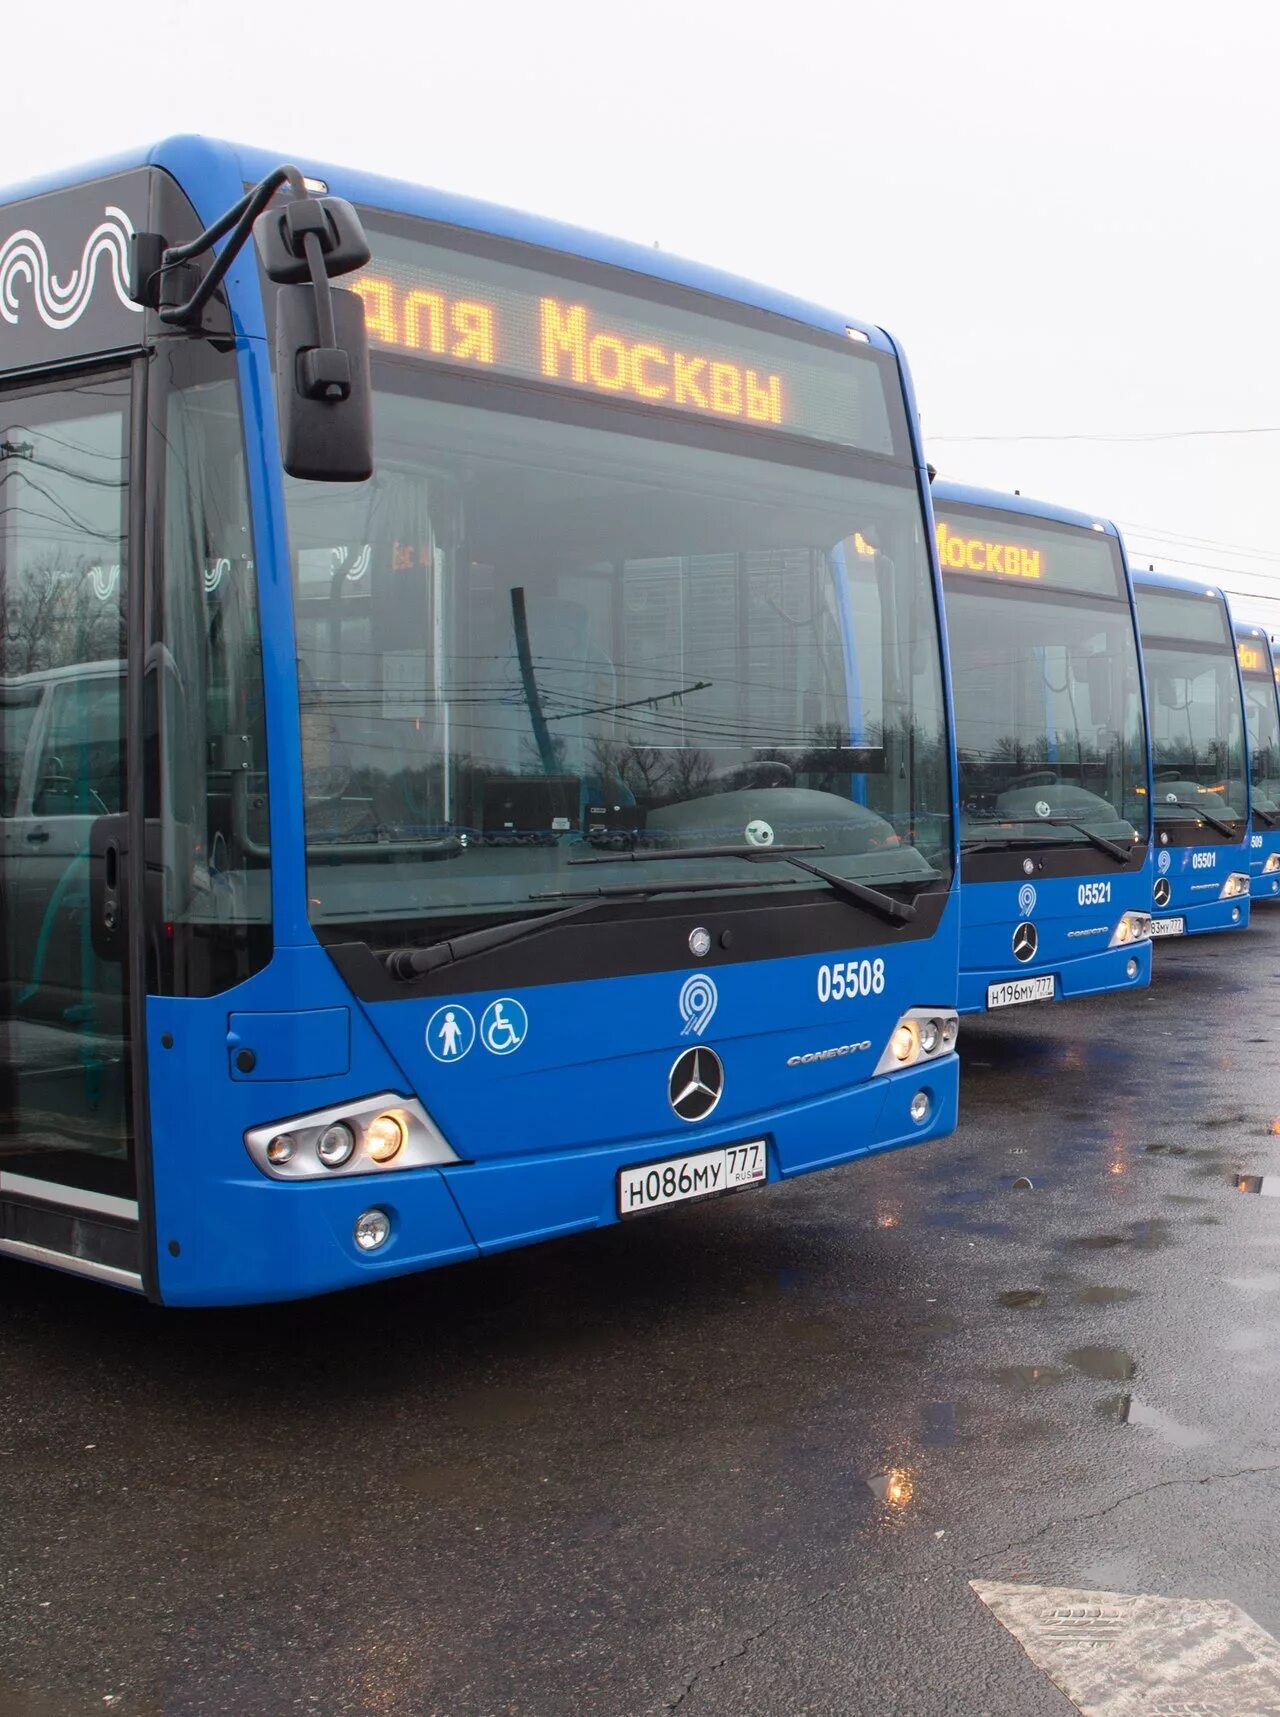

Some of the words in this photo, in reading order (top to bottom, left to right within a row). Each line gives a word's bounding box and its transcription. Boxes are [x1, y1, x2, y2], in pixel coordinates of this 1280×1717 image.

[540, 298, 782, 424] Москвы
[1192, 852, 1216, 869] 05501
[1078, 881, 1111, 905] 05521
[817, 958, 885, 1003] 05508
[992, 984, 1035, 1005] Н196МУ
[1036, 977, 1051, 993] 777
[787, 1040, 872, 1066] CONECTO
[630, 1162, 722, 1206] Н086МУ
[727, 1145, 760, 1174] 777
[735, 1170, 752, 1182] RUS
